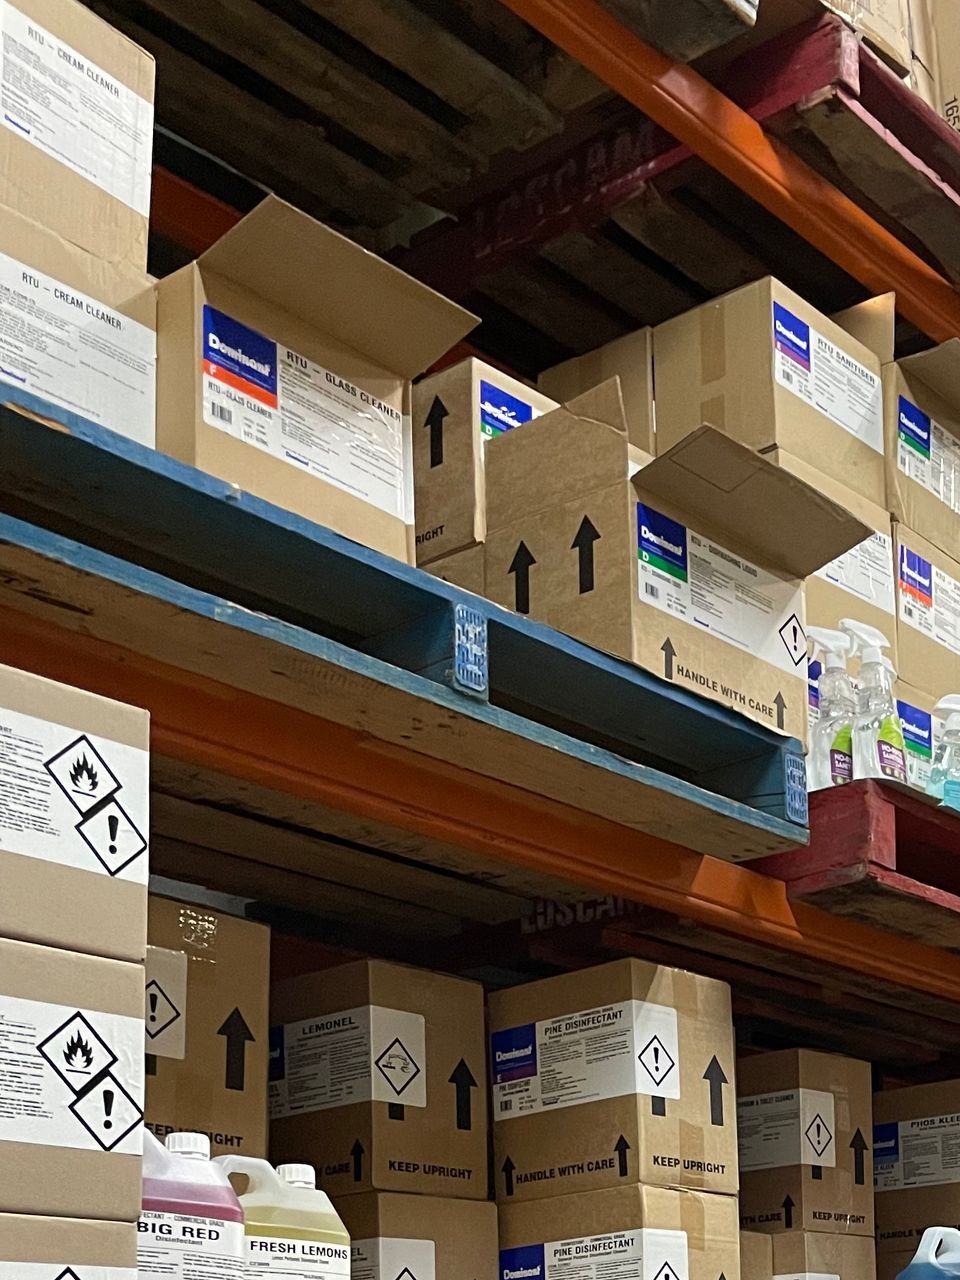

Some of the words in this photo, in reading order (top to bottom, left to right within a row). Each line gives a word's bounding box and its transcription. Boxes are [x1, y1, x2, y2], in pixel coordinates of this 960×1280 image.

[86, 68, 120, 97] CLEANER
[22, 272, 40, 289] RTU
[54, 288, 84, 310] CREAM
[86, 304, 122, 331] CLEANER
[286, 350, 308, 369] RTU
[325, 372, 358, 397] GLASS
[360, 393, 402, 423] CLEANER
[676, 664, 719, 693] HANDLE
[720, 682, 747, 705] WITH
[748, 696, 775, 719] CARE
[302, 1016, 356, 1036] LEMONEL
[544, 1023, 563, 1037] PINE
[565, 1010, 624, 1032] DISINFECTANT
[388, 1159, 420, 1173] KEEP
[422, 1164, 473, 1180] UPRIGHT
[516, 1168, 556, 1185] HANDLE
[558, 1163, 585, 1177] WITH
[586, 1157, 616, 1172] CARE
[652, 1155, 681, 1168] KEEP
[682, 1159, 726, 1175] UPRIGHT
[812, 1210, 833, 1221] KEEP
[833, 1213, 866, 1224] UPRIGHT
[137, 1221, 173, 1236] BIG
[181, 1226, 221, 1241] RED
[250, 1240, 297, 1256] FRESH
[301, 1244, 349, 1261] LEMONS
[553, 1246, 573, 1258] PINE
[574, 1237, 636, 1256] DISINFECTANT
